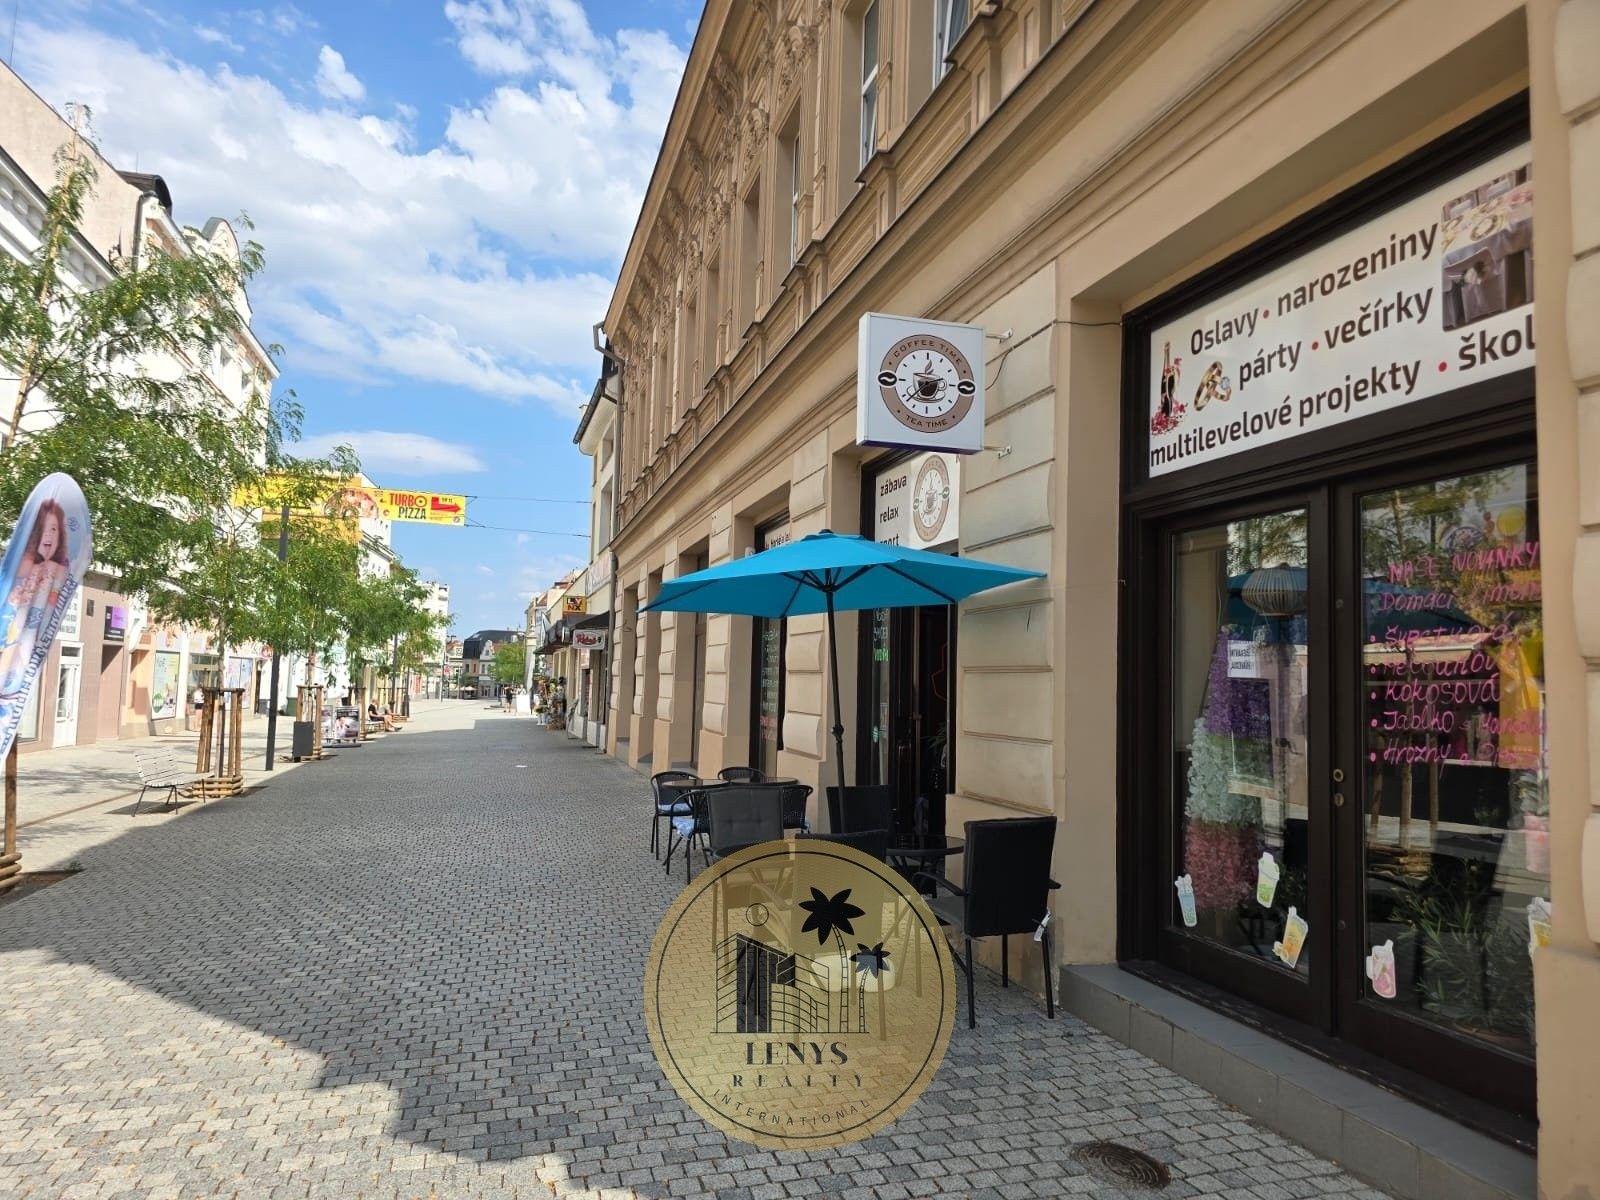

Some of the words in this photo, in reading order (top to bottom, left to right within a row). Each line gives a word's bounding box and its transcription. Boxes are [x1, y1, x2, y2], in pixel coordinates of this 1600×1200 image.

[1190, 307, 1259, 355] Oslavy
[1277, 222, 1439, 317] narozeniny
[1239, 339, 1302, 391] párty
[1324, 287, 1434, 350] večírky
[893, 339, 935, 359] COFFEE
[940, 343, 963, 365] TIME
[905, 414, 923, 428] TEA
[926, 418, 948, 429] TIME
[1150, 399, 1292, 467] multilevelové
[1299, 359, 1421, 427] projekty
[880, 475, 907, 497] zábava
[389, 493, 428, 508] TURBO
[398, 506, 427, 520] PIZZA
[880, 506, 899, 524] relax
